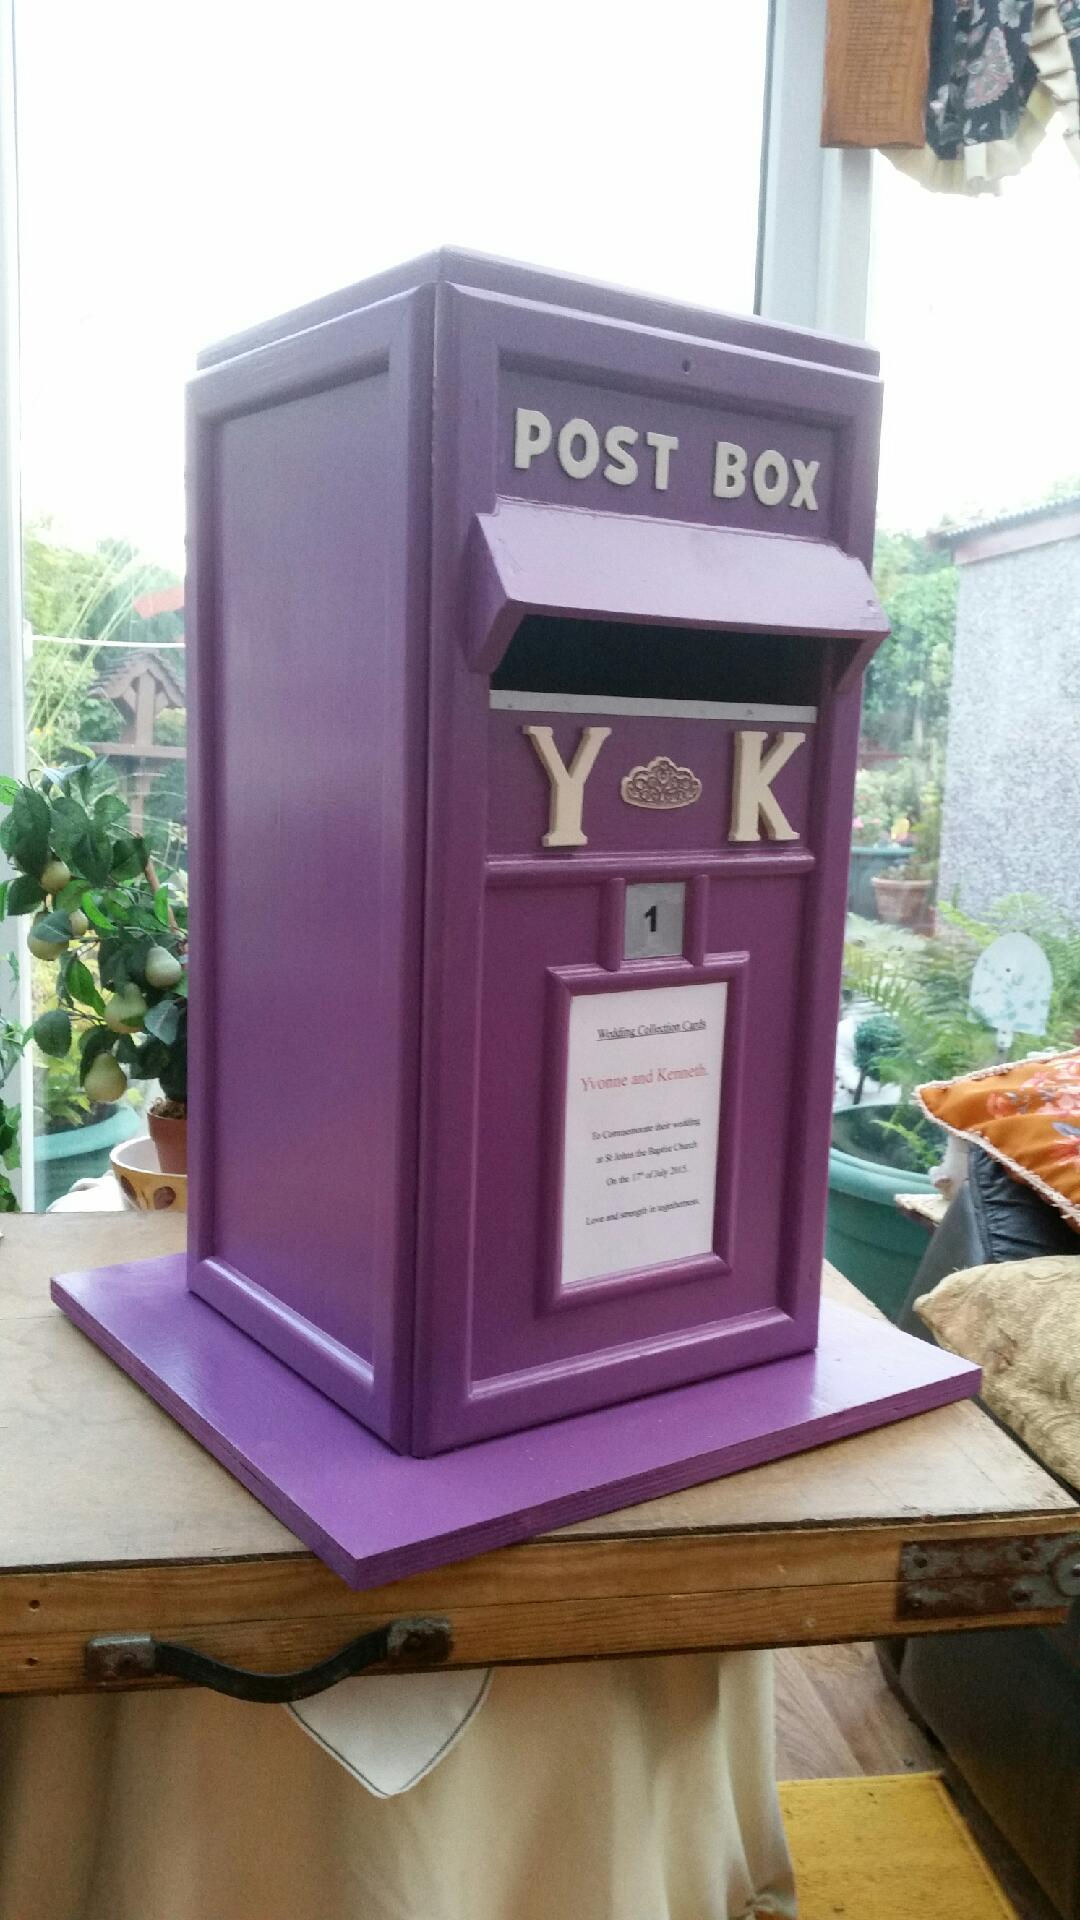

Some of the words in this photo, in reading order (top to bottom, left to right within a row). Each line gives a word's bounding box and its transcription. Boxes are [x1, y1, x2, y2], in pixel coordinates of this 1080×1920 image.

[513, 408, 679, 490] POST
[713, 441, 821, 511] BOX
[523, 725, 612, 847] Y
[728, 730, 806, 842] K
[643, 905, 657, 932] 1
[597, 1026, 635, 1040] Wedding
[638, 1022, 680, 1036] Collection
[682, 1019, 707, 1032] Cards
[580, 1075, 628, 1091] Yvonne
[631, 1070, 653, 1085] and
[636, 1149, 647, 1157] the
[673, 1141, 697, 1152] Church
[606, 1178, 617, 1186] On
[619, 1176, 629, 1184] the
[652, 1168, 668, 1179] July
[586, 1217, 605, 1225] Love
[606, 1212, 618, 1221] and
